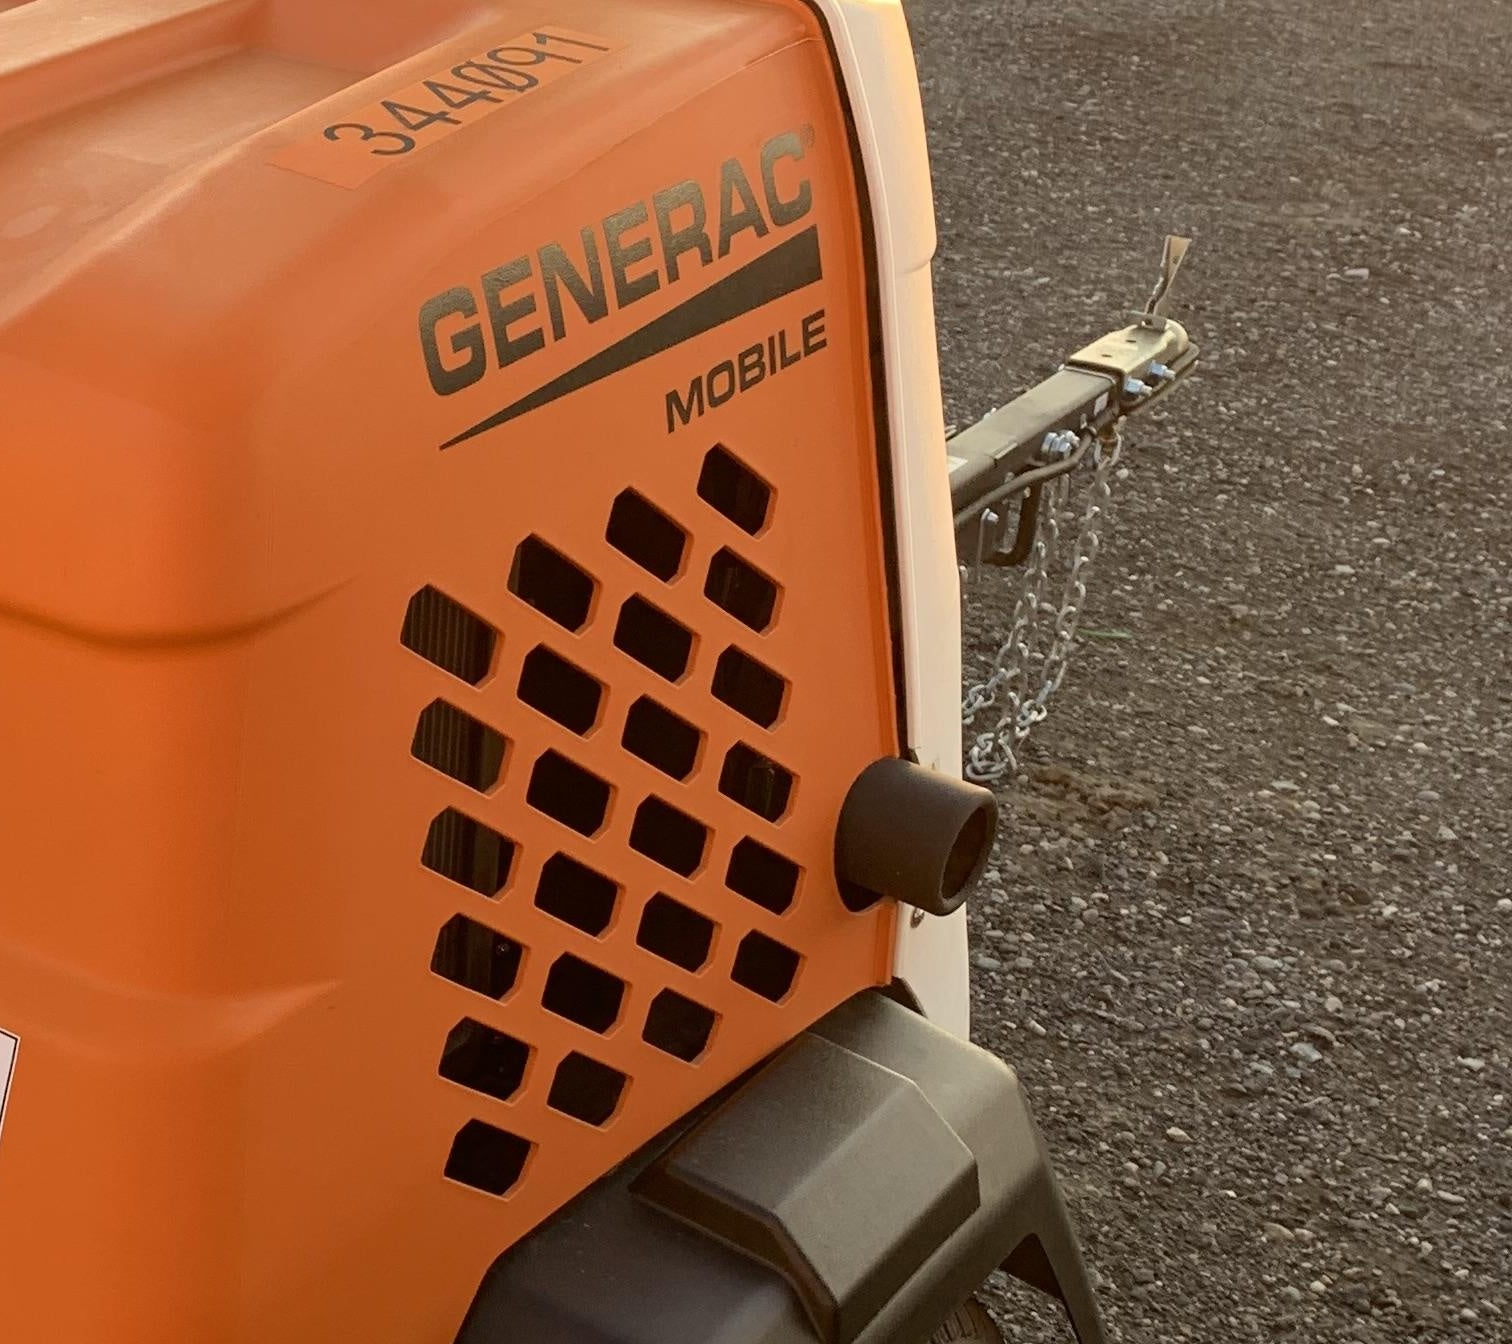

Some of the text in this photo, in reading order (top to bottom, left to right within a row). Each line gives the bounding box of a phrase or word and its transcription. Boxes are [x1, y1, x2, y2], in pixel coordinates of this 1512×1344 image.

[323, 32, 610, 157] 344091
[417, 130, 815, 398] GENERAC
[664, 308, 828, 434] MOBILE
